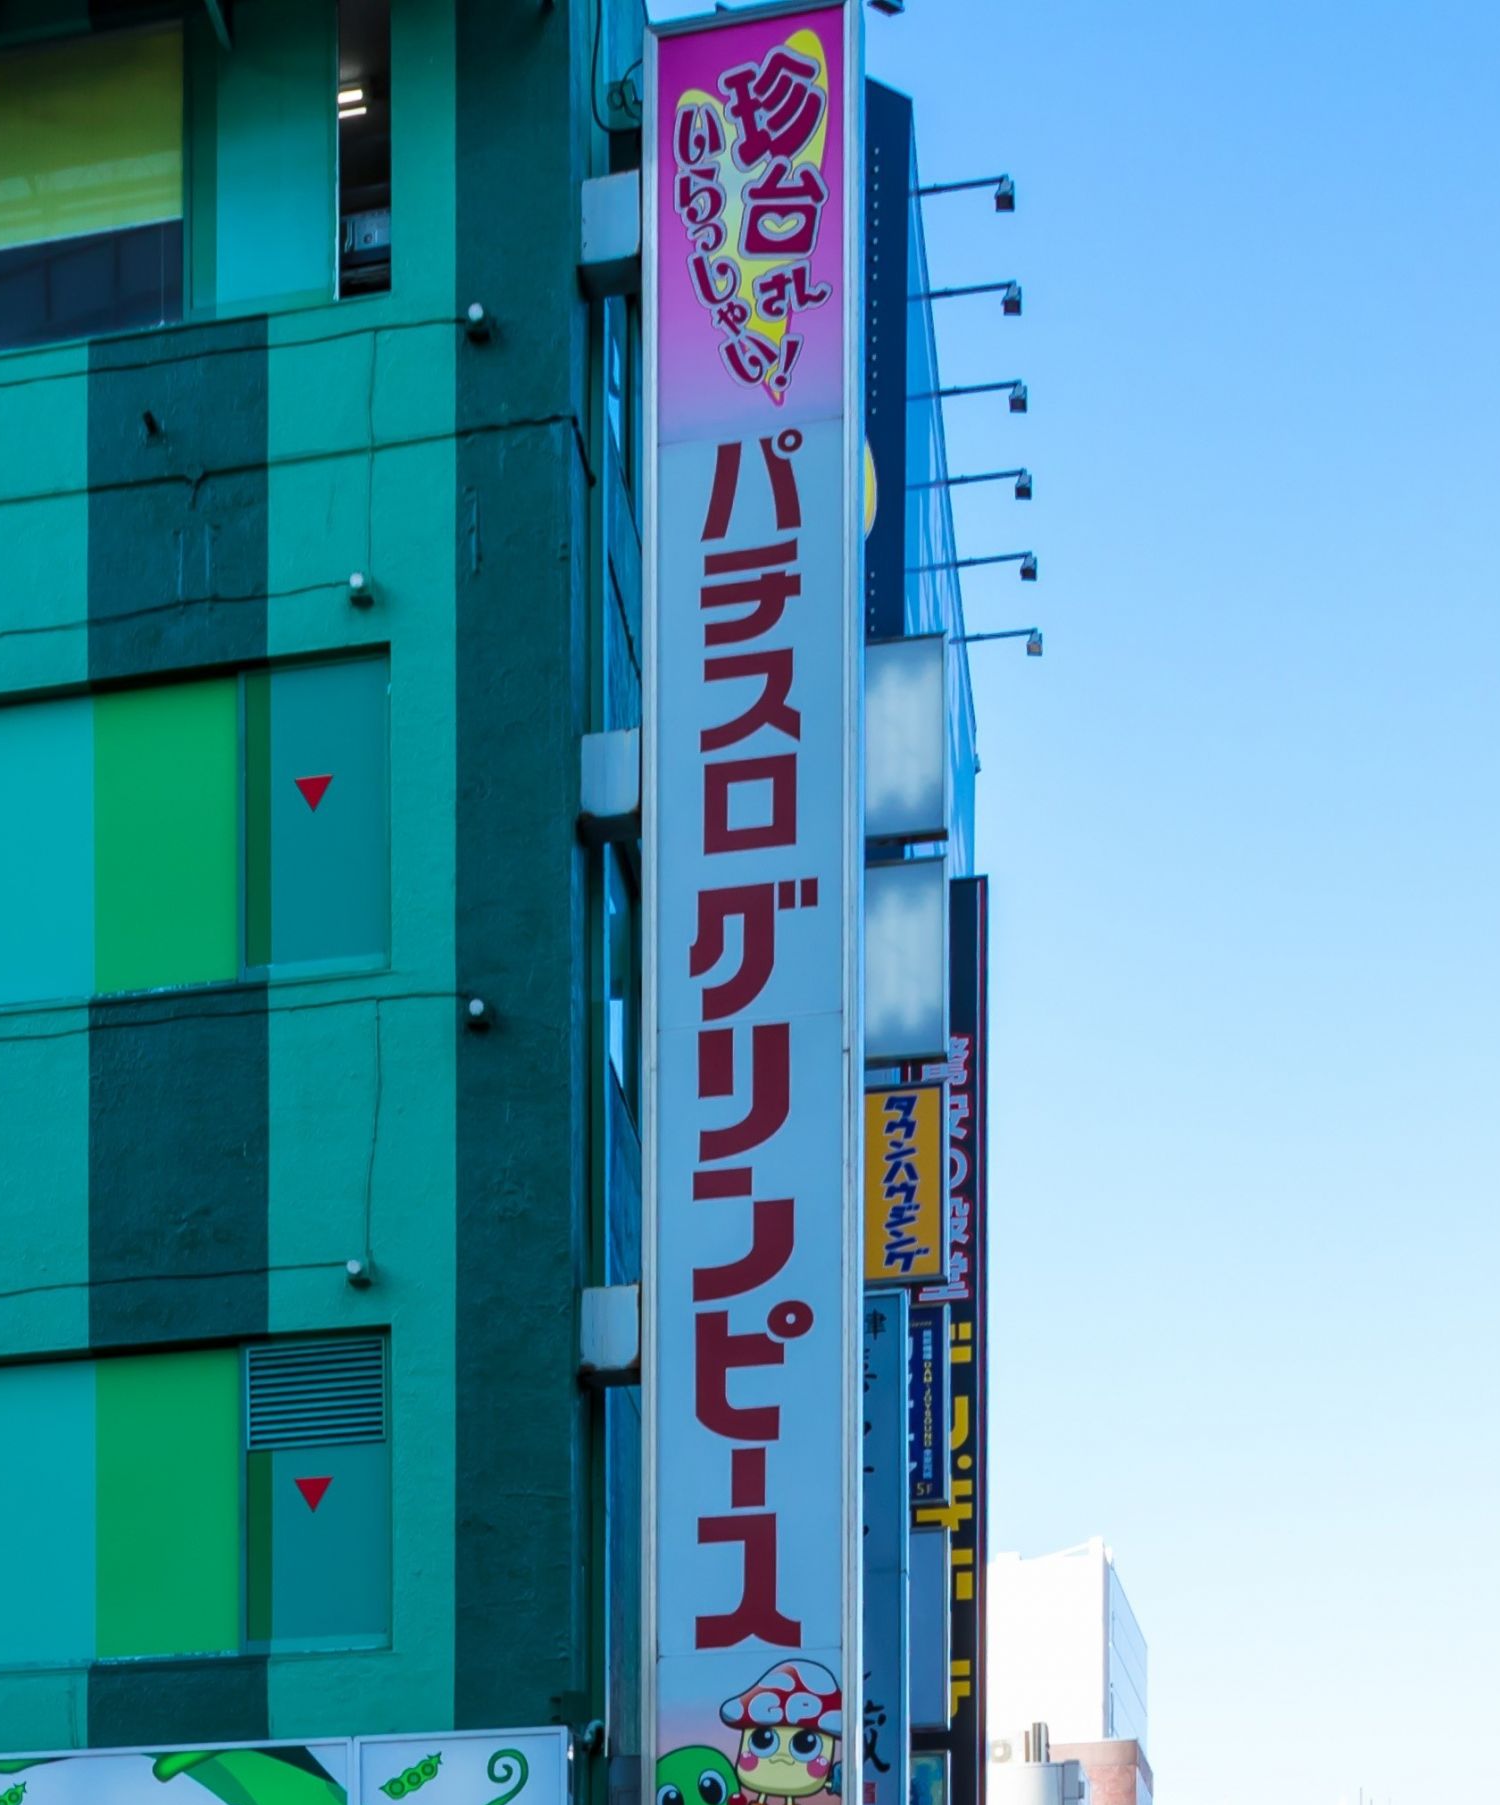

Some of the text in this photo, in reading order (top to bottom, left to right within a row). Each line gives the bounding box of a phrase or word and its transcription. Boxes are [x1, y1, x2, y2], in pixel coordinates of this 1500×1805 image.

[719, 46, 832, 322] 珍台さん
[883, 1094, 930, 1274] タウンハウジング
